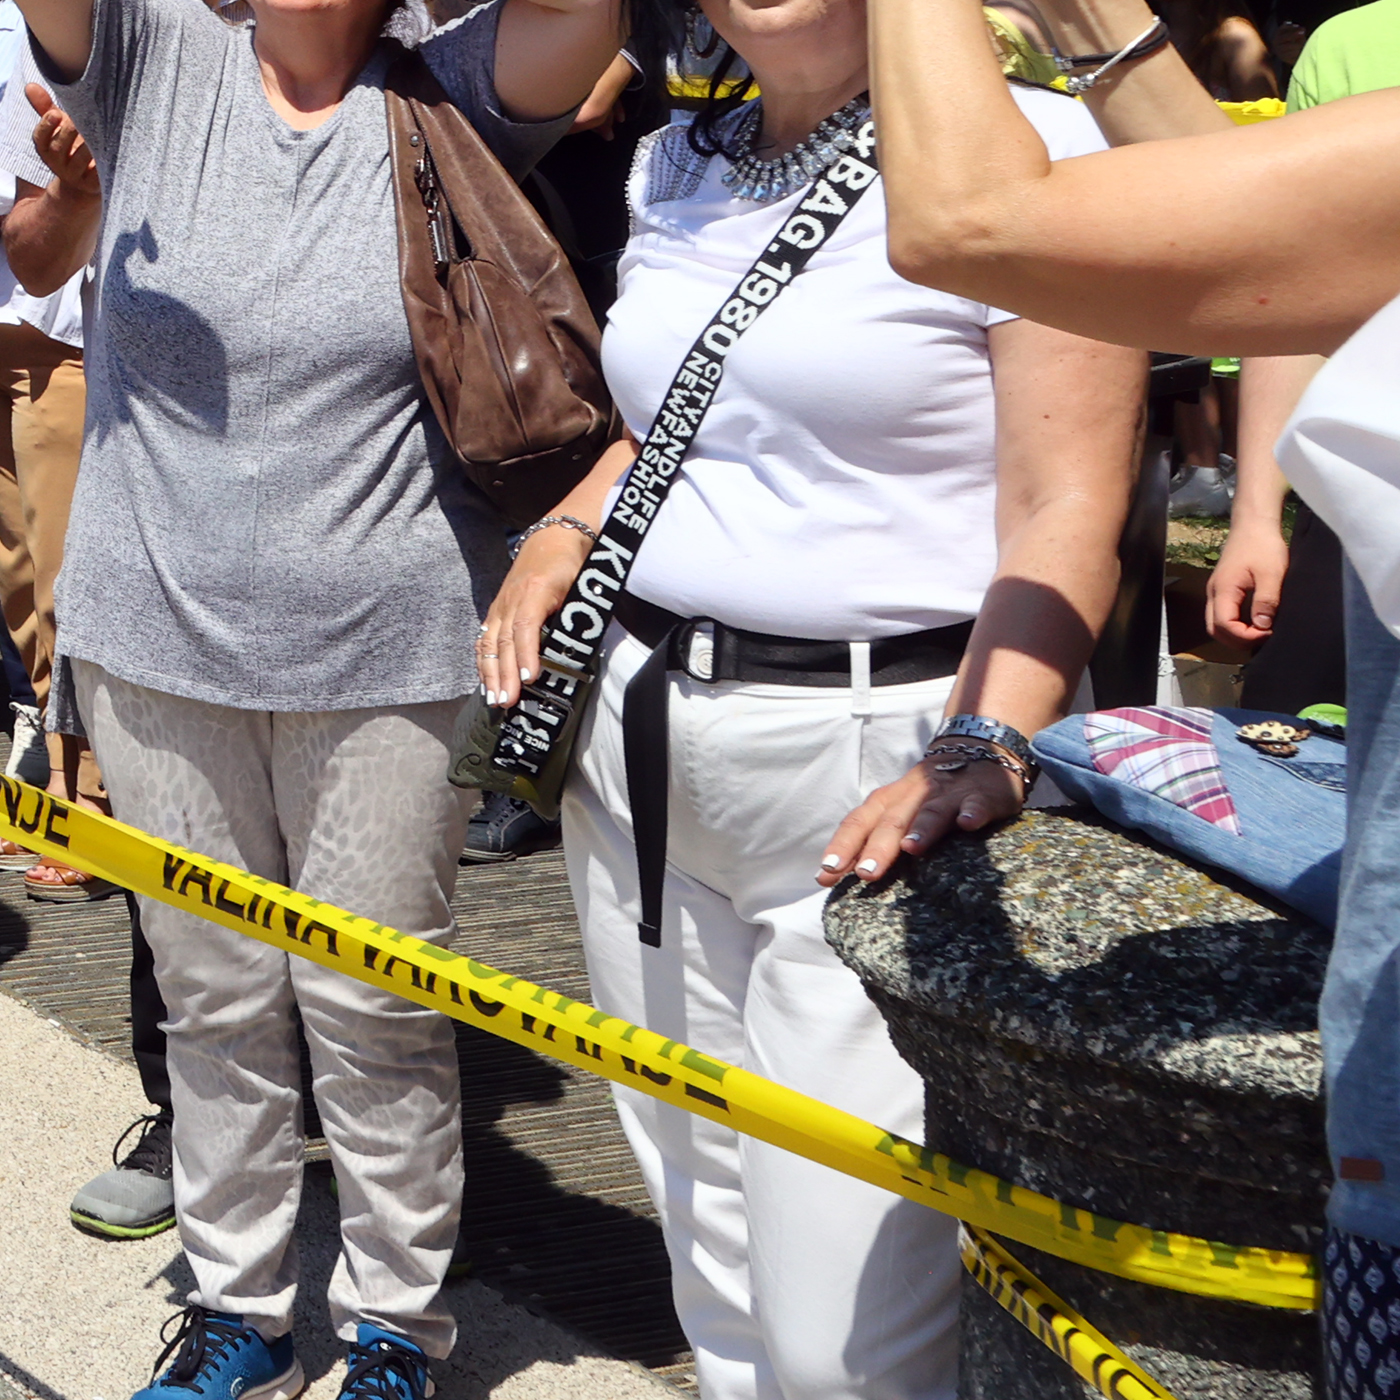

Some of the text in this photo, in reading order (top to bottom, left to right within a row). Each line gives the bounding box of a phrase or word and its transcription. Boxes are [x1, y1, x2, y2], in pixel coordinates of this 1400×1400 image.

[612, 350, 710, 525] NEWFASHION
[628, 361, 722, 535] CITYANDLIFE
[524, 734, 550, 752] NICE
